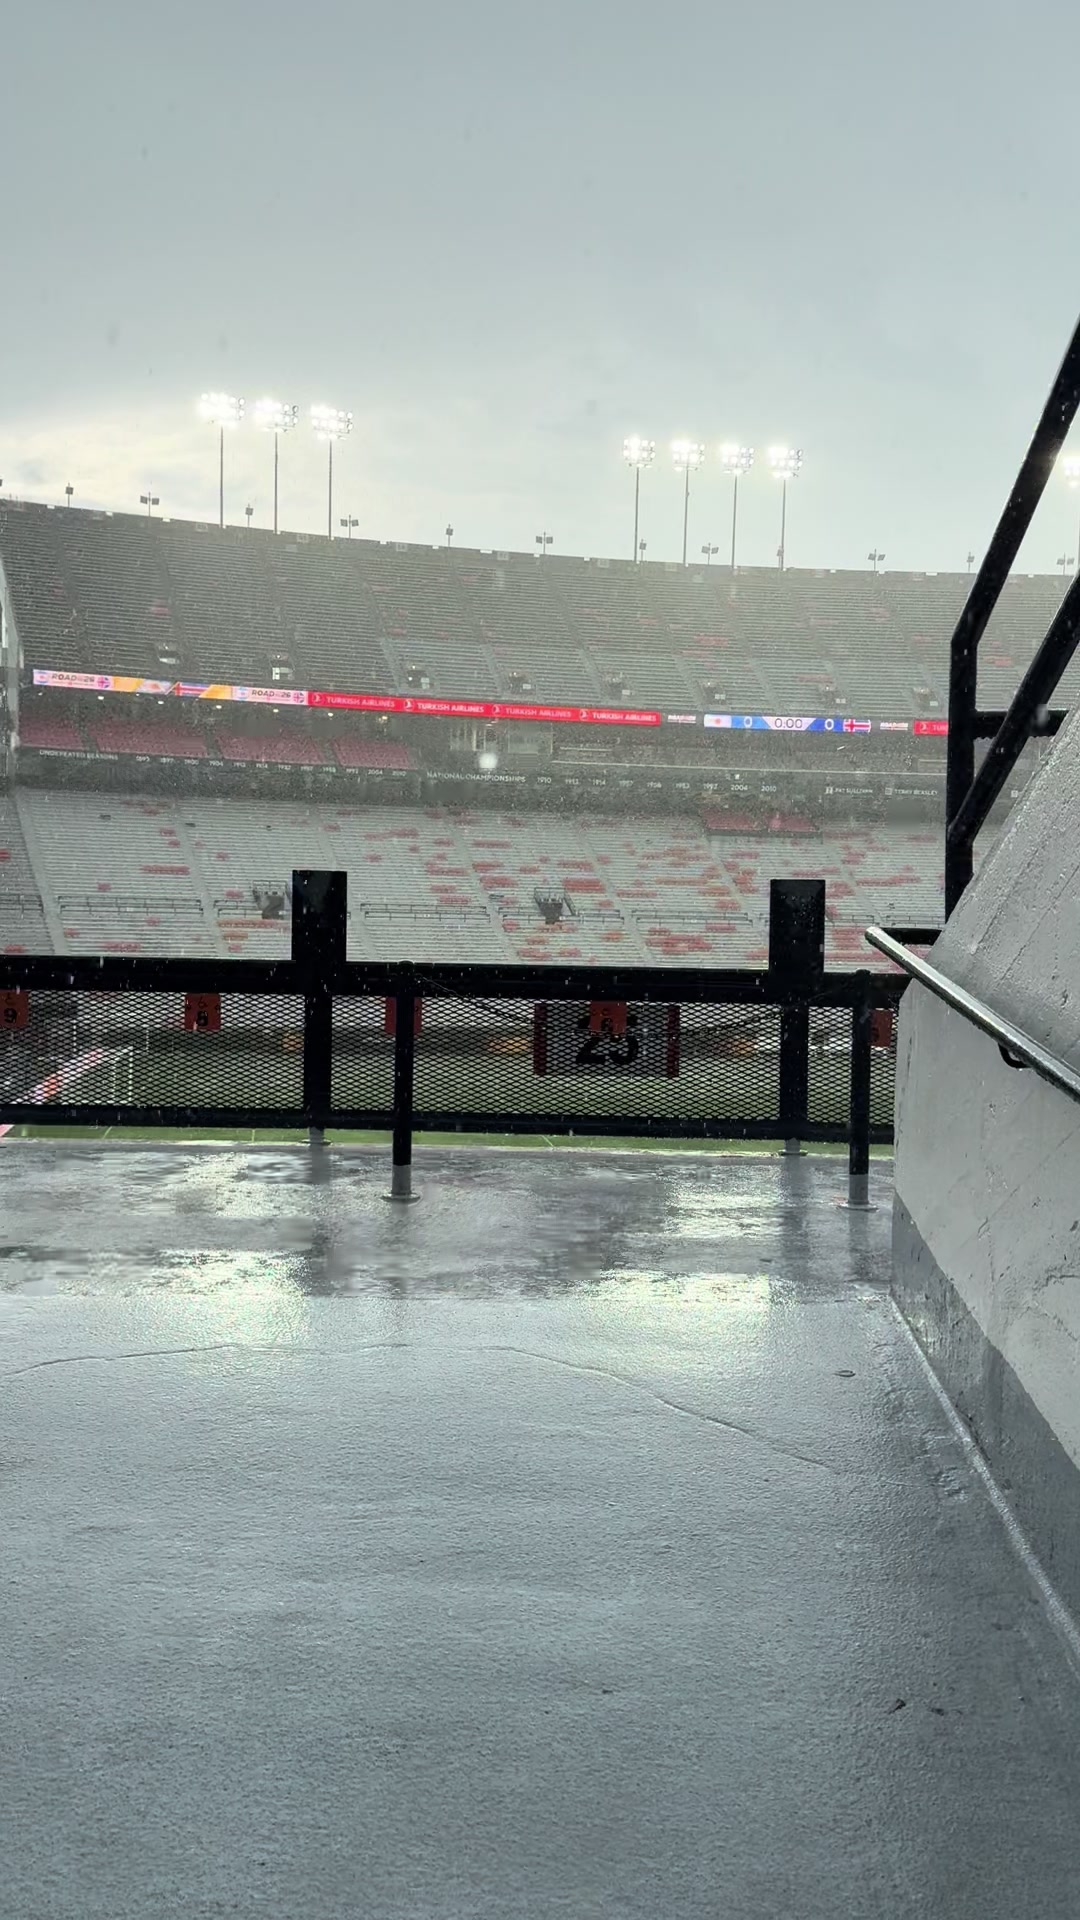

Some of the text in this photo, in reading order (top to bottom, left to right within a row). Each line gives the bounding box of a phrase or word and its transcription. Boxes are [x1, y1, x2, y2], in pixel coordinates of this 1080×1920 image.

[52, 673, 77, 681] ROAD
[252, 689, 275, 697] ROAD
[327, 697, 395, 709] TURKISH AIRLINES
[417, 702, 485, 713] TURKISH AIRLINES
[505, 707, 572, 719] TURKISH AIRLINES
[592, 711, 624, 720] TURKISH
[625, 713, 657, 722] AIRLINES
[743, 716, 753, 727] 0
[774, 717, 803, 729] 0:00
[824, 718, 834, 730] 0
[427, 771, 465, 781] NATIONAL
[465, 773, 527, 783] CHAMPIONSHIPS
